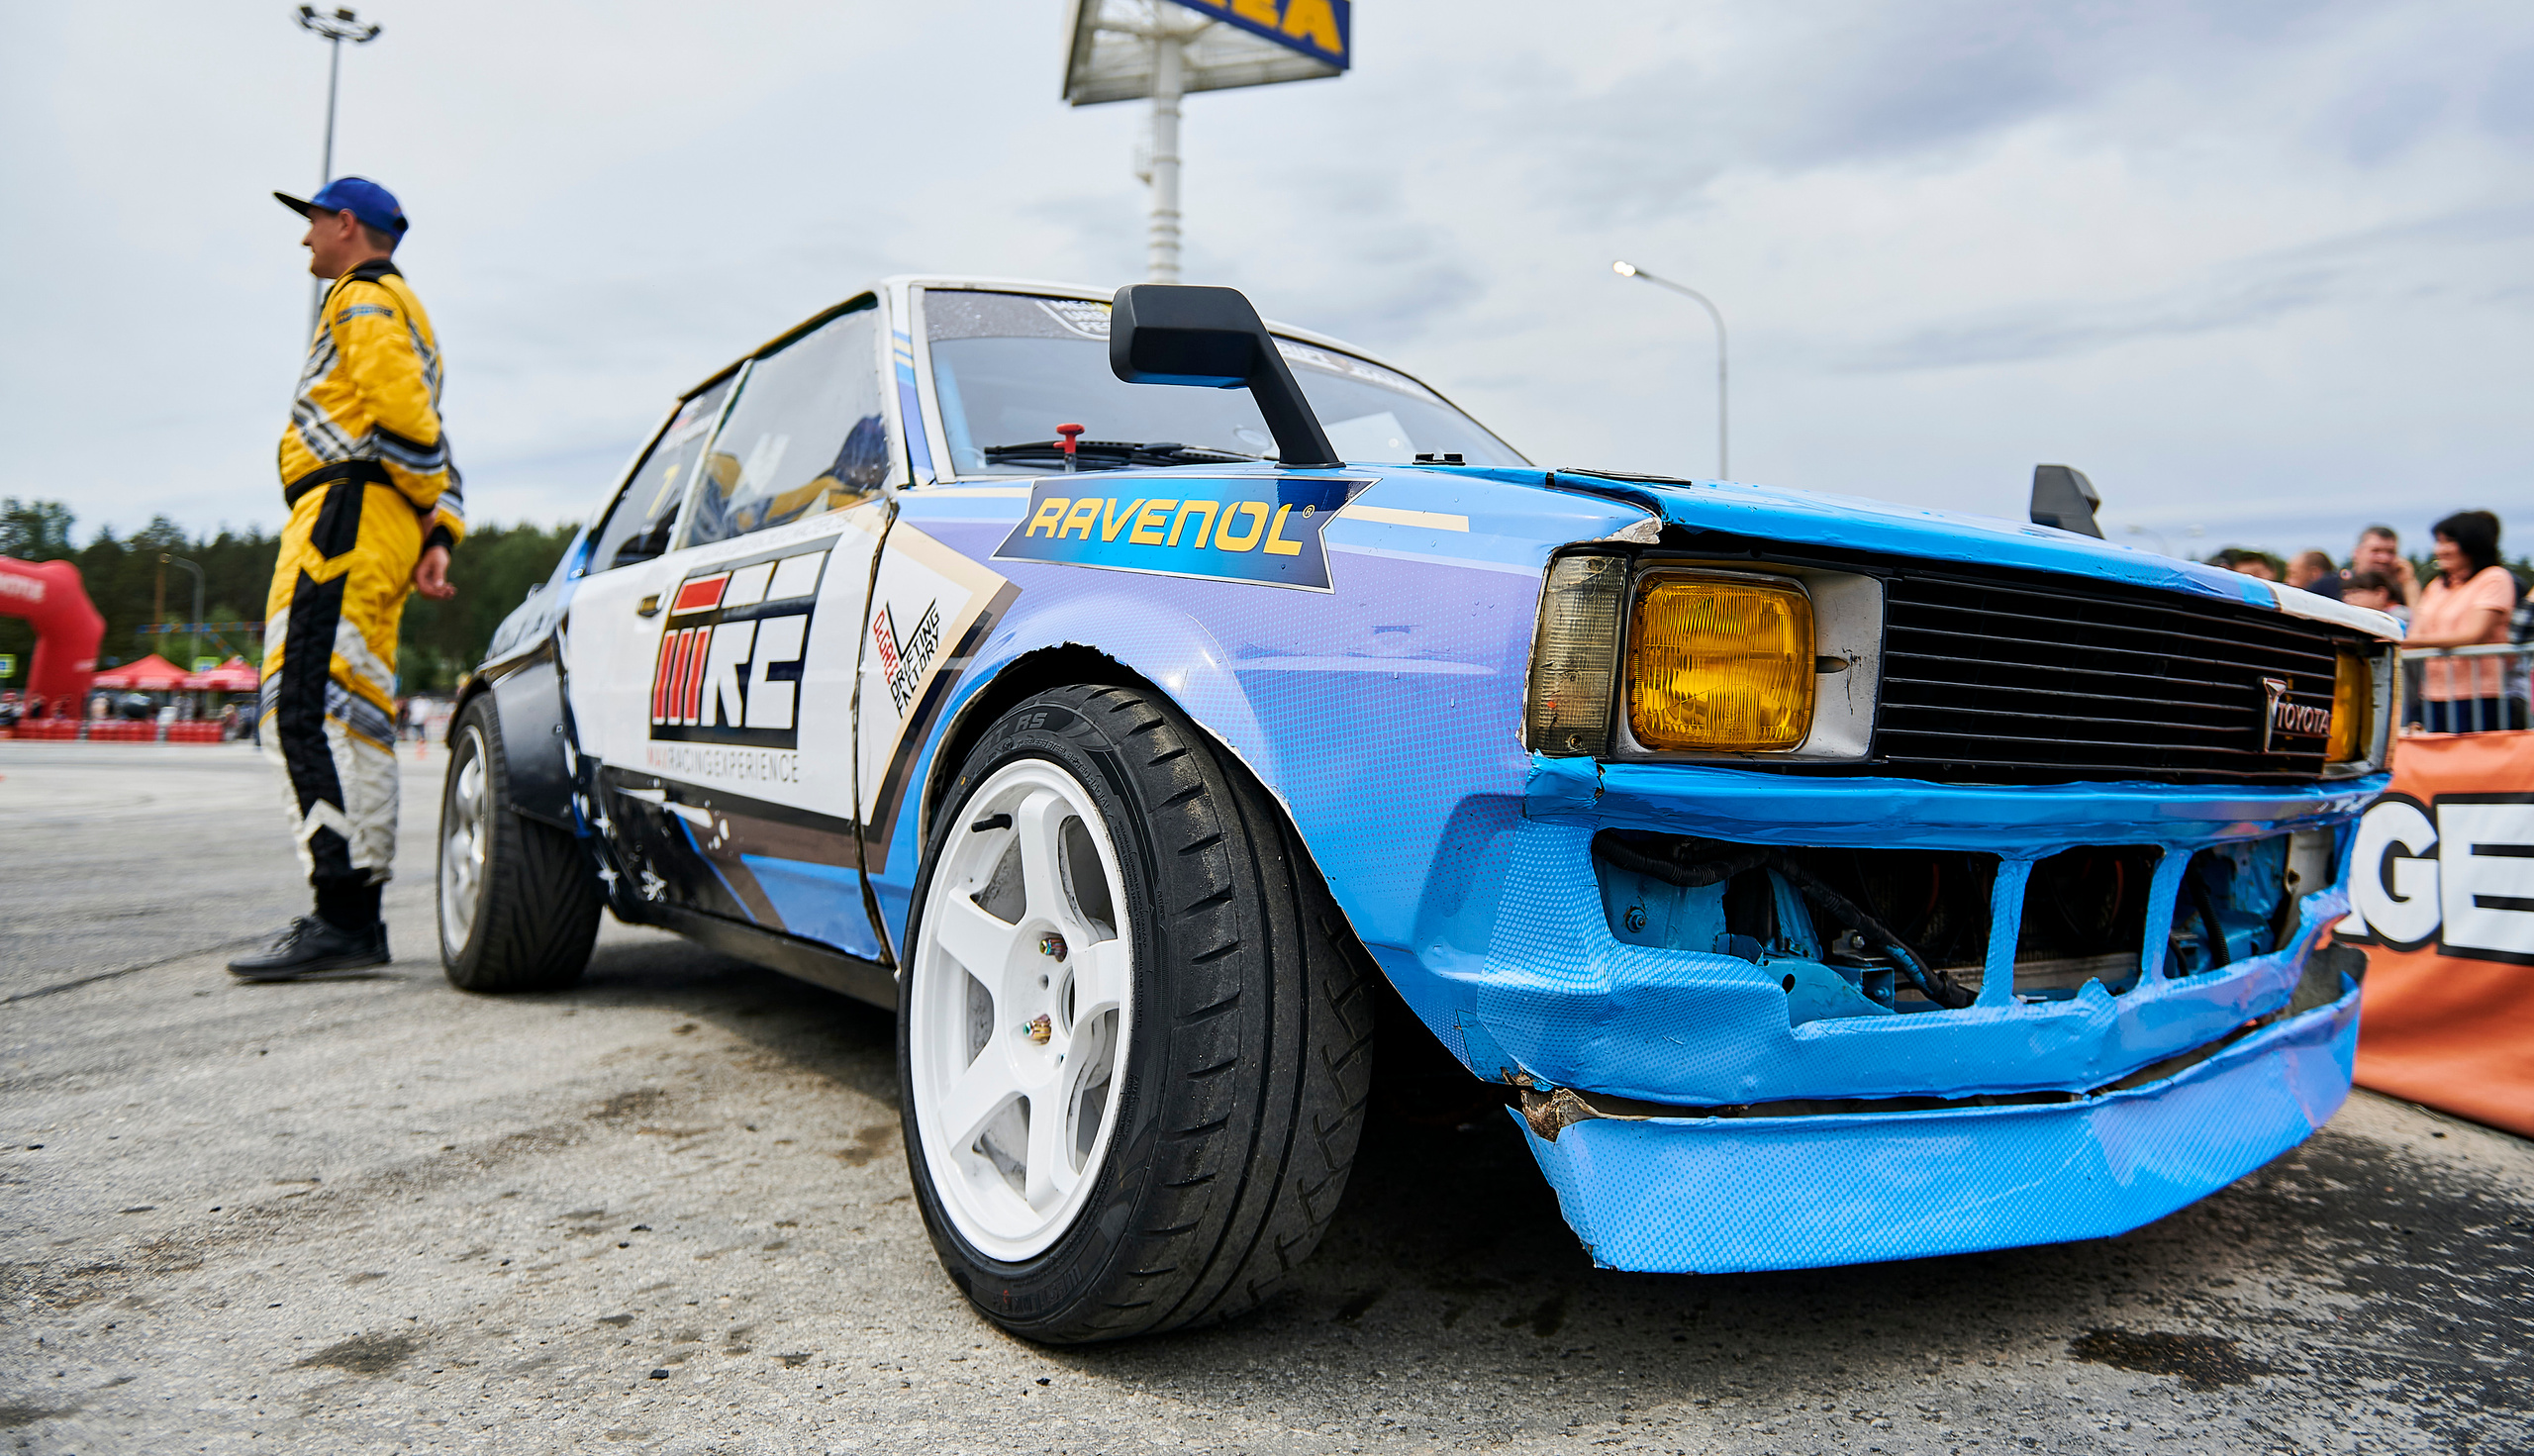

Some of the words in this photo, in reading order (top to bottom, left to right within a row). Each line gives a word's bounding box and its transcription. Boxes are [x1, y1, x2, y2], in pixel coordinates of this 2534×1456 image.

[1202, 0, 1343, 54] EA
[890, 606, 940, 703] DRIFTING
[896, 626, 939, 720] FACTORY
[1014, 712, 1048, 733] RS
[2278, 702, 2331, 734] TOYOTA
[2334, 800, 2534, 954] GE
